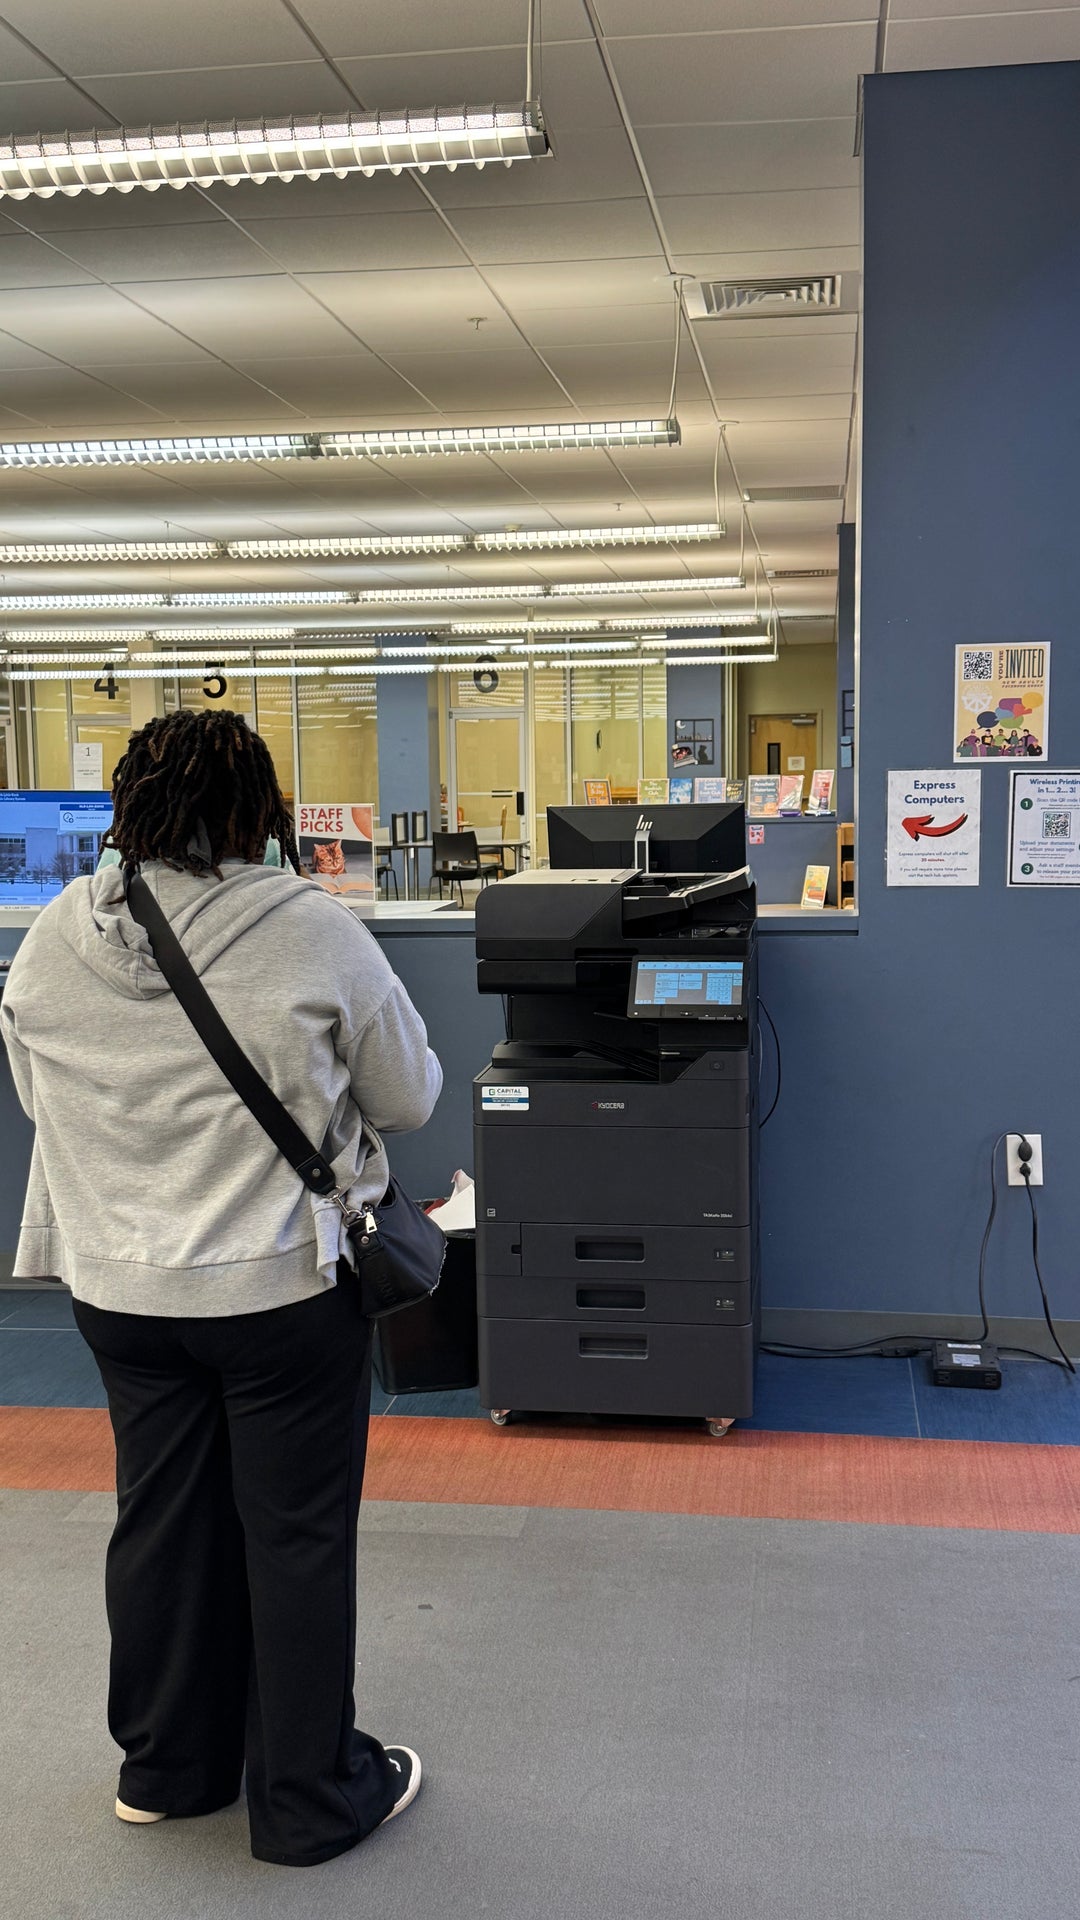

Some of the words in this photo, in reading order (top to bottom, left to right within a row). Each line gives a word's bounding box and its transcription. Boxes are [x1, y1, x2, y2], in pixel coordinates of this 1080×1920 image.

[1005, 648, 1044, 678] INVITED
[473, 654, 499, 693] 6
[94, 662, 119, 699] 4
[203, 661, 227, 699] 5
[85, 747, 91, 756] 1
[913, 780, 956, 791] Express
[904, 794, 965, 806] Computers
[300, 808, 343, 820] STAFF
[300, 821, 343, 832] PICKS
[1024, 865, 1031, 873] 3
